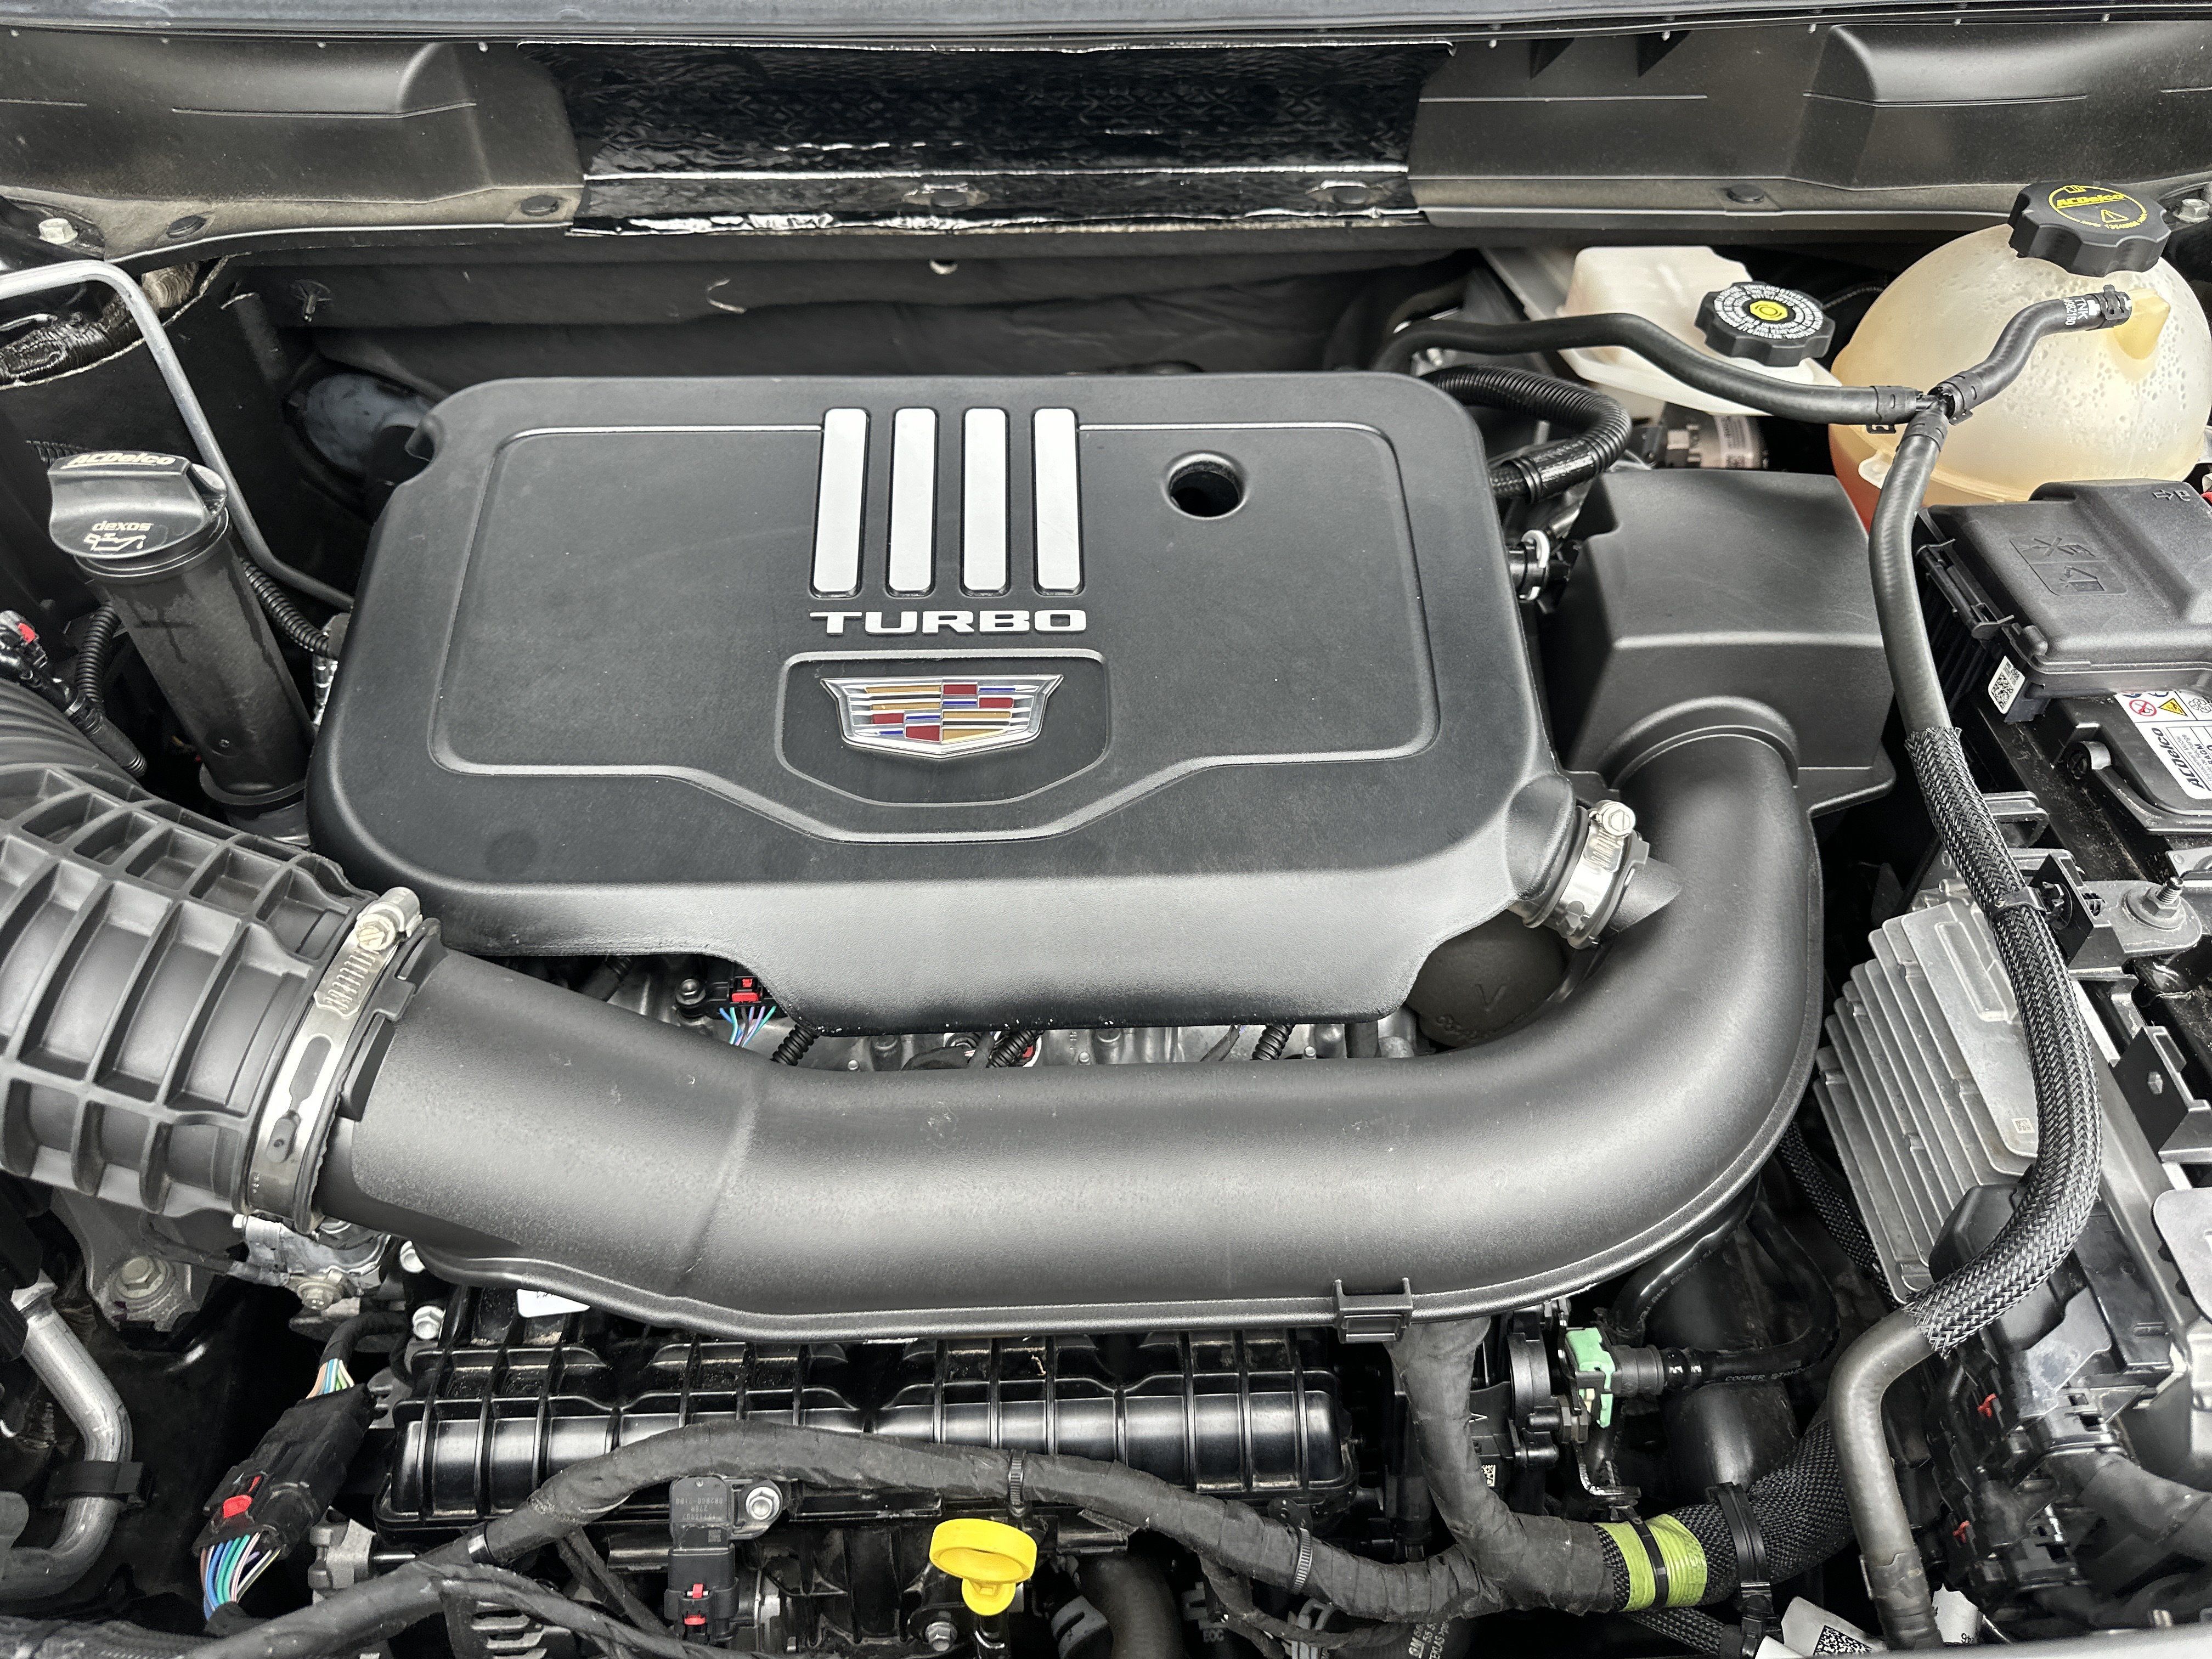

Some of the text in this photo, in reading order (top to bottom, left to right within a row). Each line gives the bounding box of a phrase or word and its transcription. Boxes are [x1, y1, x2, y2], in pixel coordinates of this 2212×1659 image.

[67, 453, 176, 465] ACDelco
[92, 521, 153, 532] dexos
[809, 609, 1087, 635] TURBO
[2151, 727, 2205, 789] ACDelco
